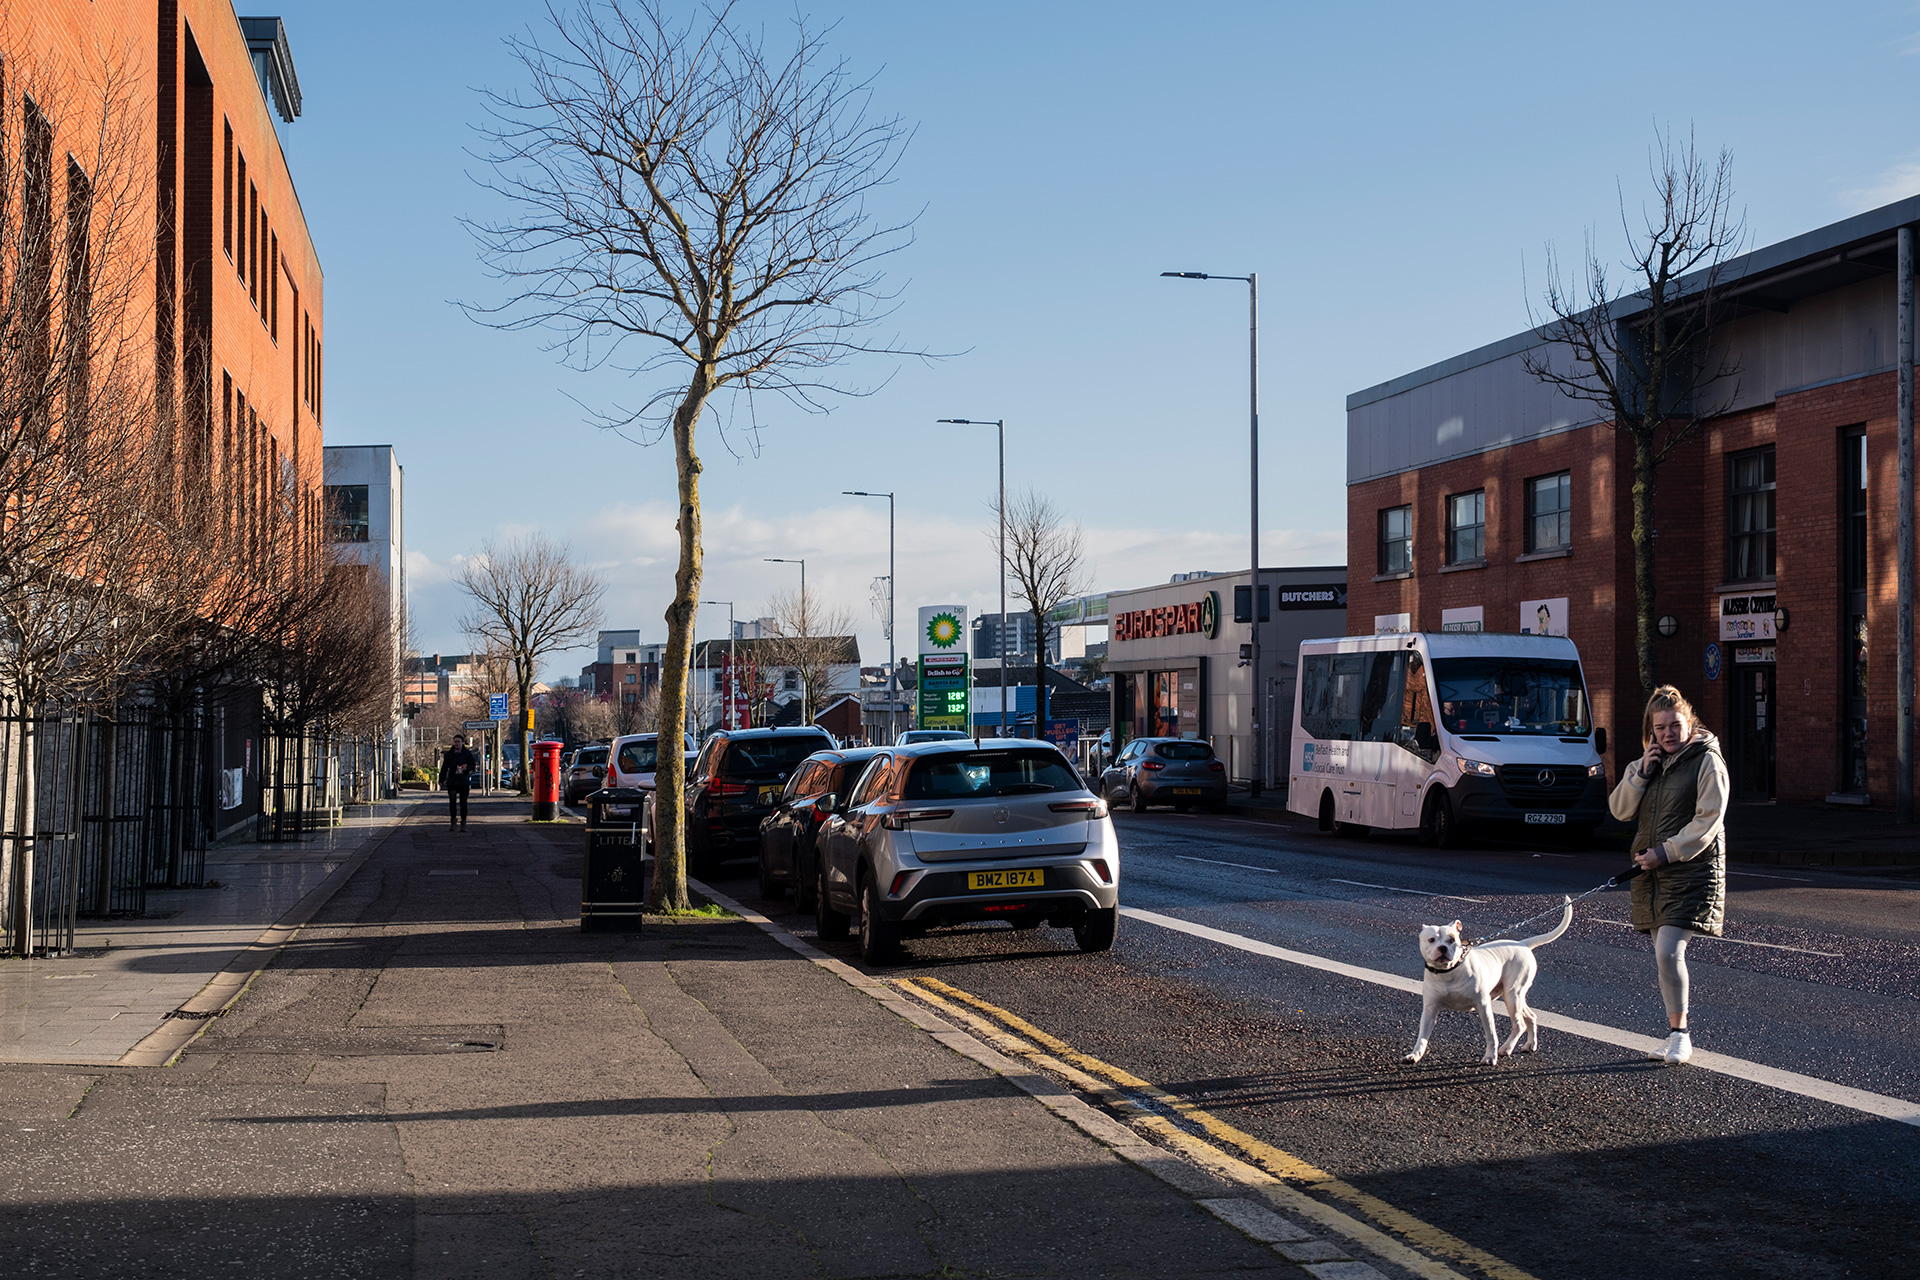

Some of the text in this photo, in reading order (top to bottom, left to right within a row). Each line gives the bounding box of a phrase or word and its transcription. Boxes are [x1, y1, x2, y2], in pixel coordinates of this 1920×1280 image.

[1281, 591, 1335, 602] BUTCHERS
[954, 606, 964, 614] bp
[1115, 602, 1202, 641] EUROSPAR
[1316, 744, 1328, 755] Belfast
[1314, 762, 1345, 774] Social Care Trust
[1528, 814, 1563, 823] RGZ 2790
[600, 836, 637, 845] LITTER
[976, 871, 1035, 887] BMZ 1874
